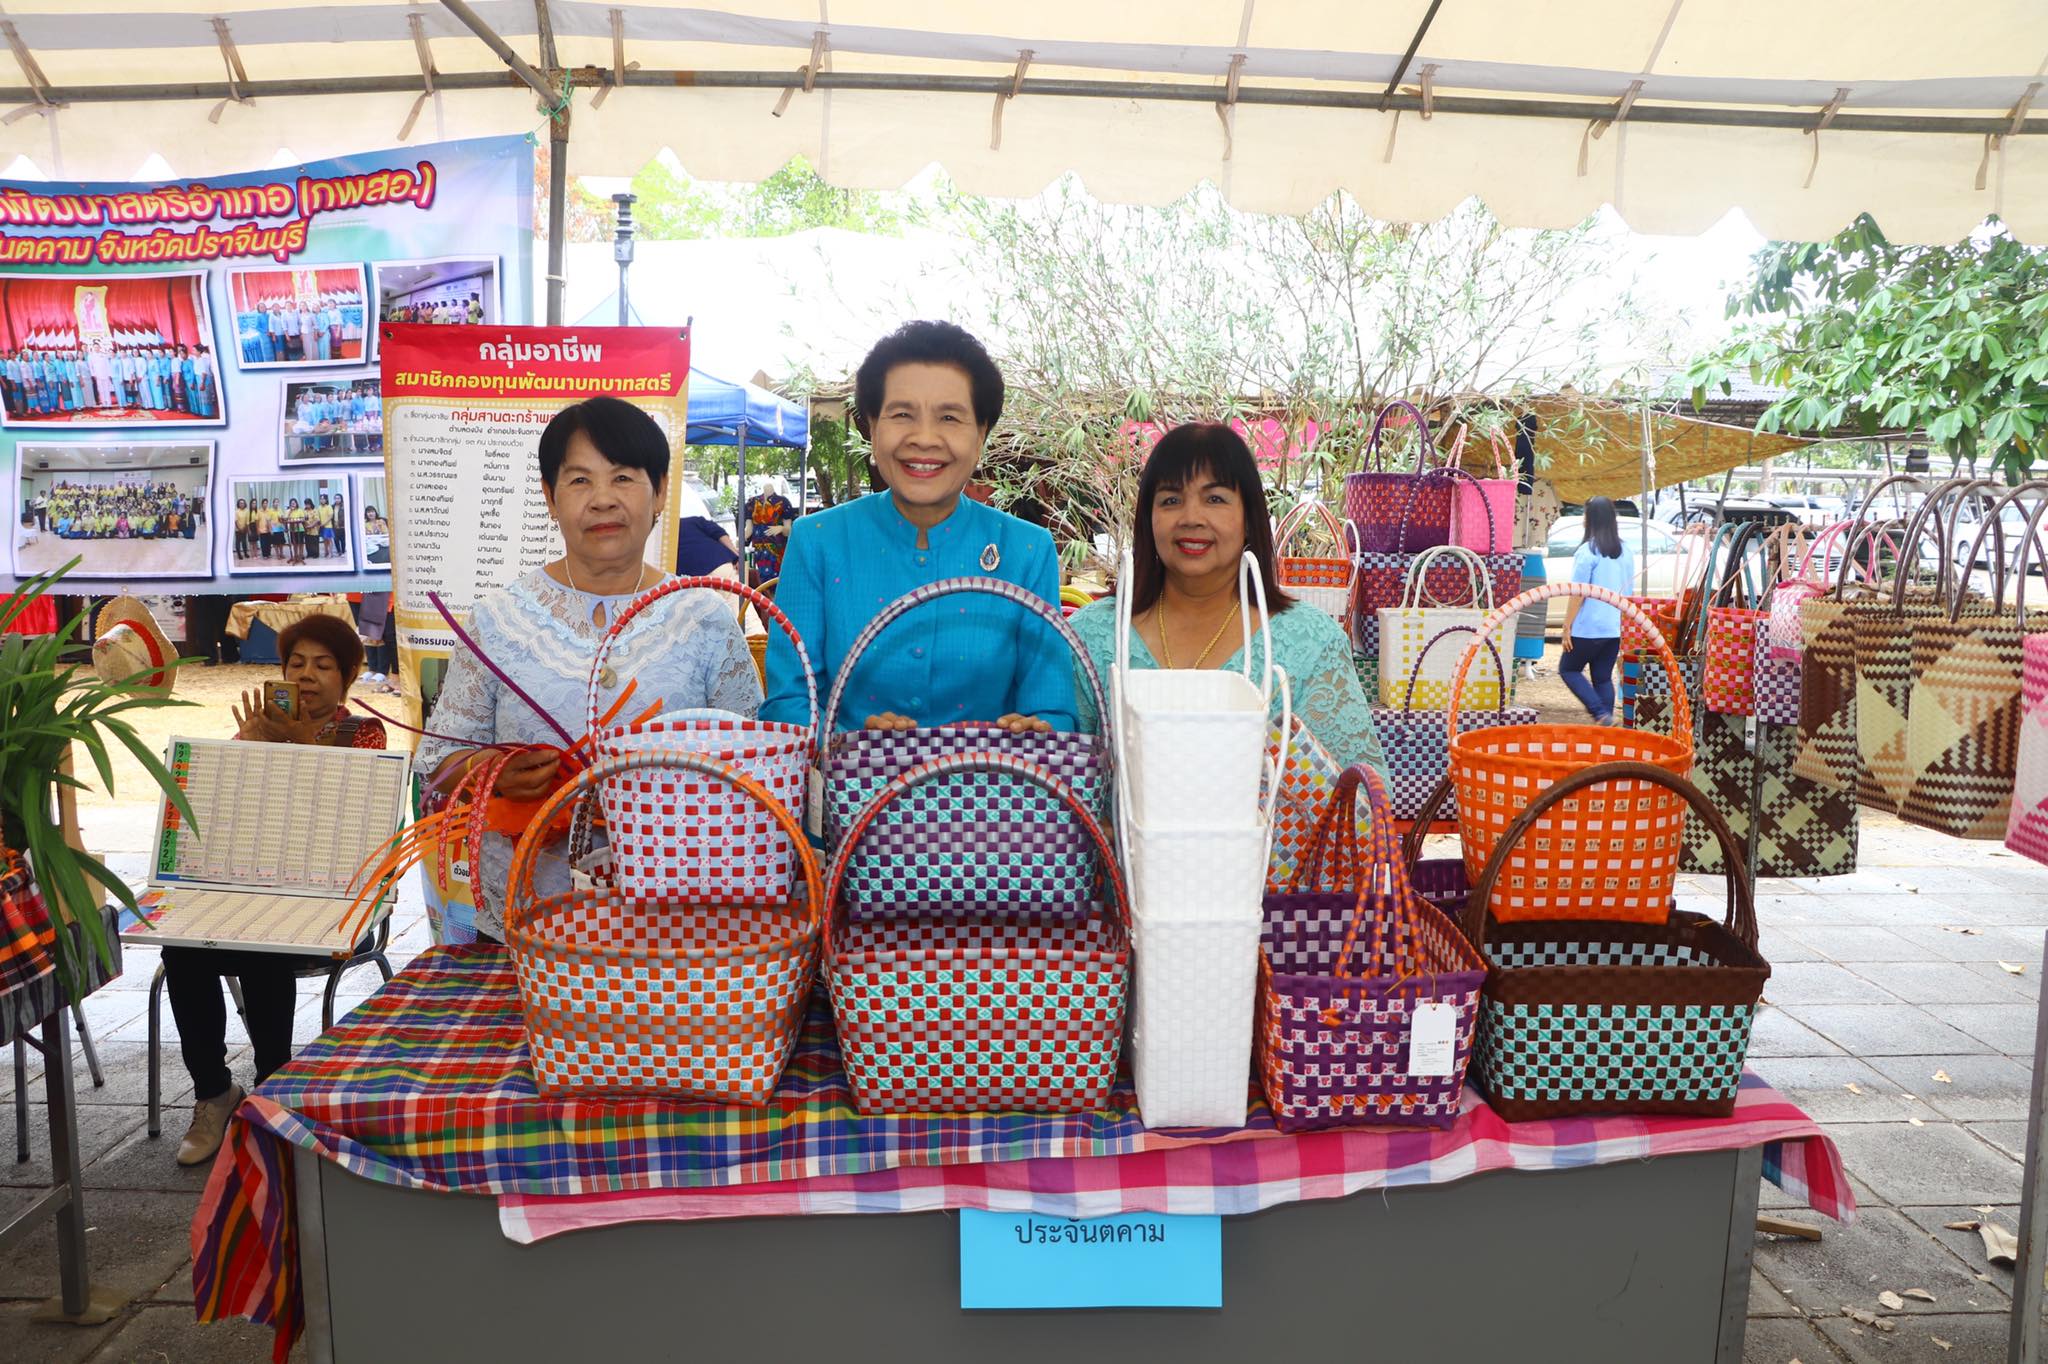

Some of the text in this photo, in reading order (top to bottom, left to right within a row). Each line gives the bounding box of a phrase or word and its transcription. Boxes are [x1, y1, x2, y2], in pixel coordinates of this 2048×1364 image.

[299, 162, 435, 217] (กพสอ.)
[99, 220, 305, 262] จังหวัดปราจีนบุรี
[479, 335, 602, 368] กลุ่มอาชีพ
[394, 370, 672, 394] สมาชิกกองทุนพัฒนาบทบาทสตรี
